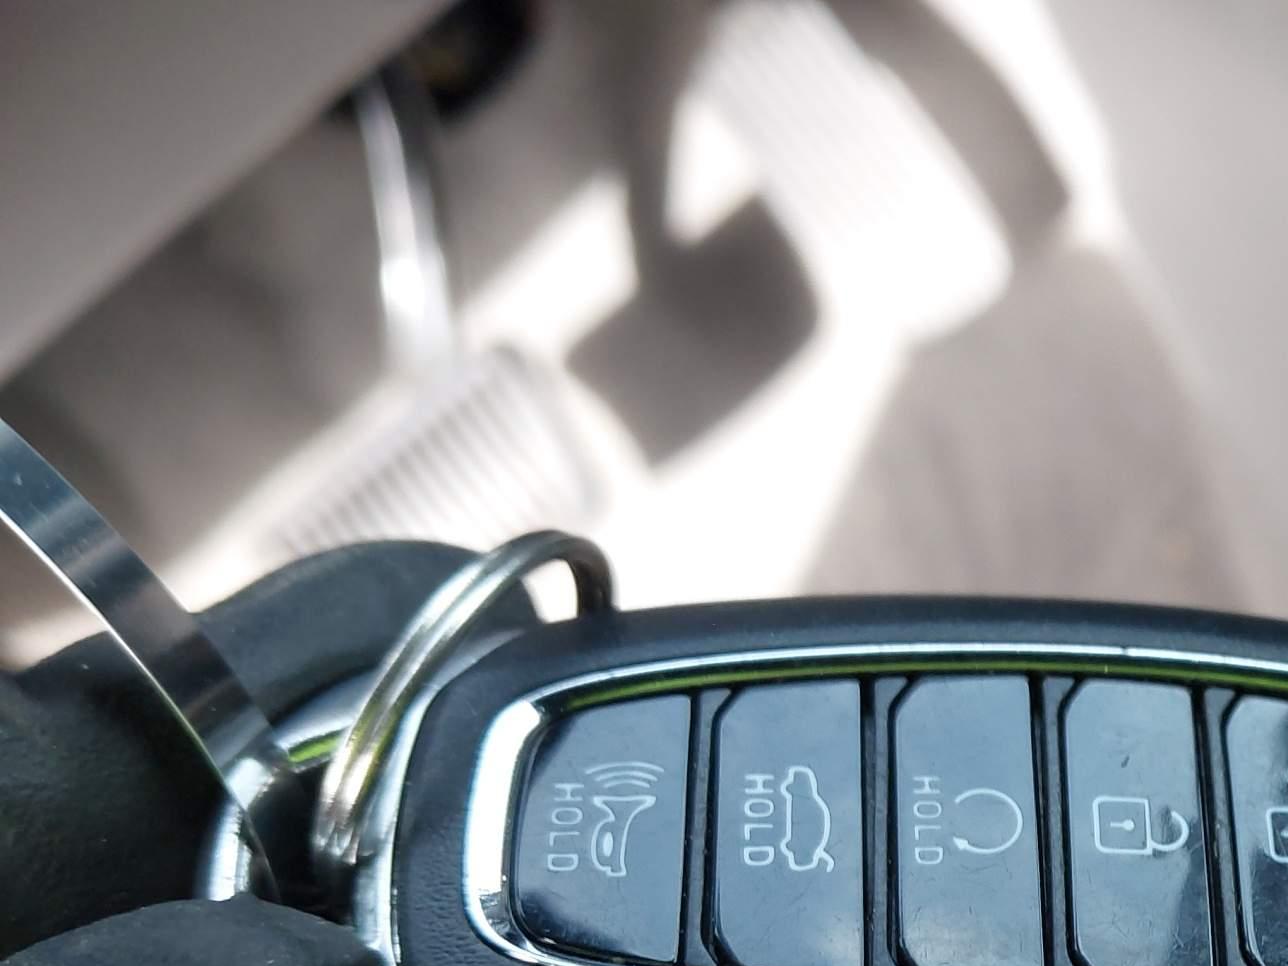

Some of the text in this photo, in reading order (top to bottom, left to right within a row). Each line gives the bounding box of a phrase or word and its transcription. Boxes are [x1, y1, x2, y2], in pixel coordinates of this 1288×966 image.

[547, 783, 585, 872] HOLD
[744, 774, 775, 866] HOLD
[912, 776, 944, 865] HOLD
